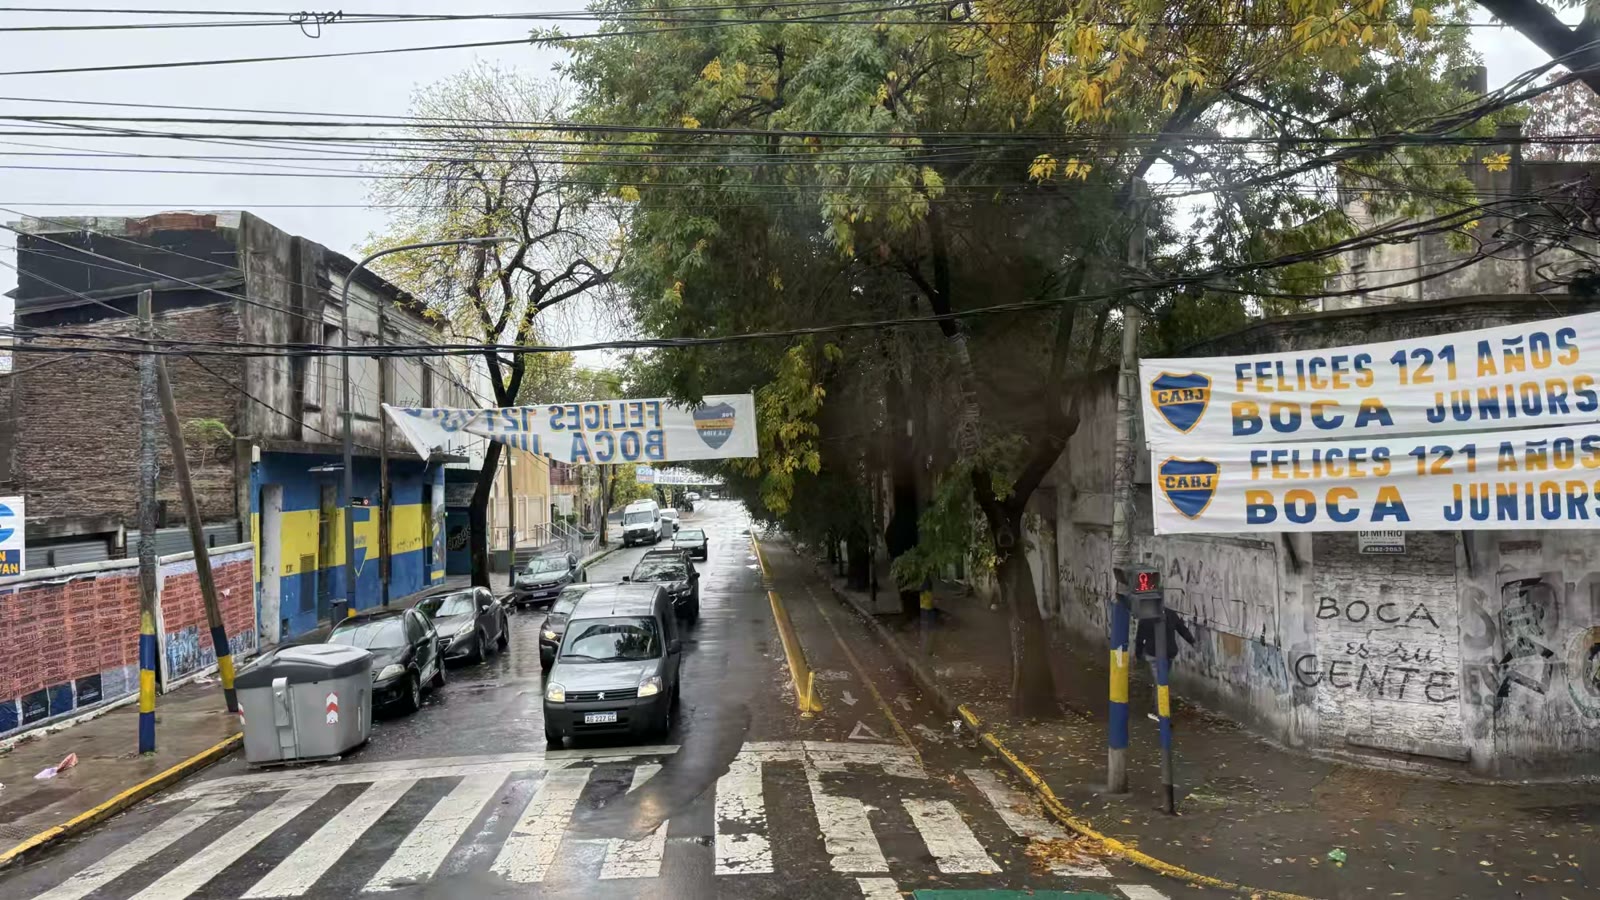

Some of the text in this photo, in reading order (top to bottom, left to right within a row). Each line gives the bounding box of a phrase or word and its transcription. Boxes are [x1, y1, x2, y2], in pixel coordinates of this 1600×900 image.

[1234, 326, 1580, 393] FELICES 121 AÑOS
[1157, 388, 1205, 404] CABJ
[1231, 374, 1599, 436] BOCA JUNIORS
[1250, 434, 1600, 480] FELICES 121 AÑOS
[1164, 474, 1212, 489] CABJ
[1244, 484, 1411, 525] BOCA
[1316, 597, 1439, 628] BOCA
[1295, 654, 1459, 702] GENTE
